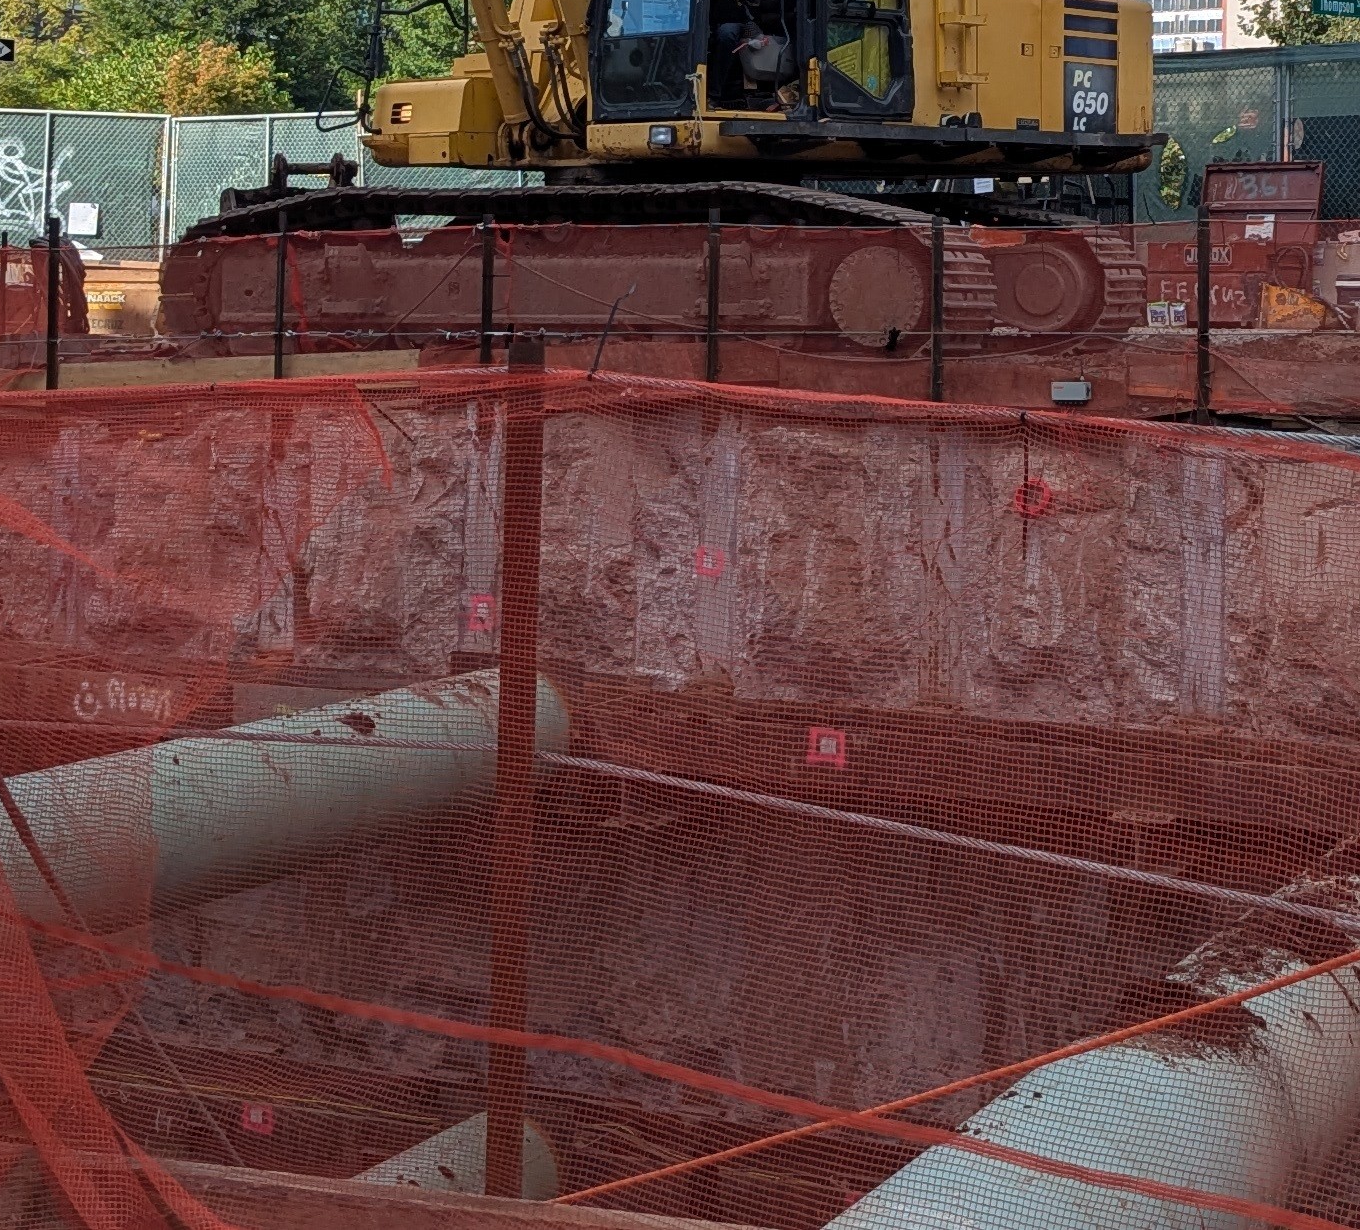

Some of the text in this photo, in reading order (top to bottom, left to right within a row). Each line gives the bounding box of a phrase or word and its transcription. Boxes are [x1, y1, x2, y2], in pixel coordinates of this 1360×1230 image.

[1073, 70, 1093, 88] PC
[1072, 91, 1109, 115] 650
[1072, 117, 1087, 131] LC
[85, 294, 126, 303] NAACK
